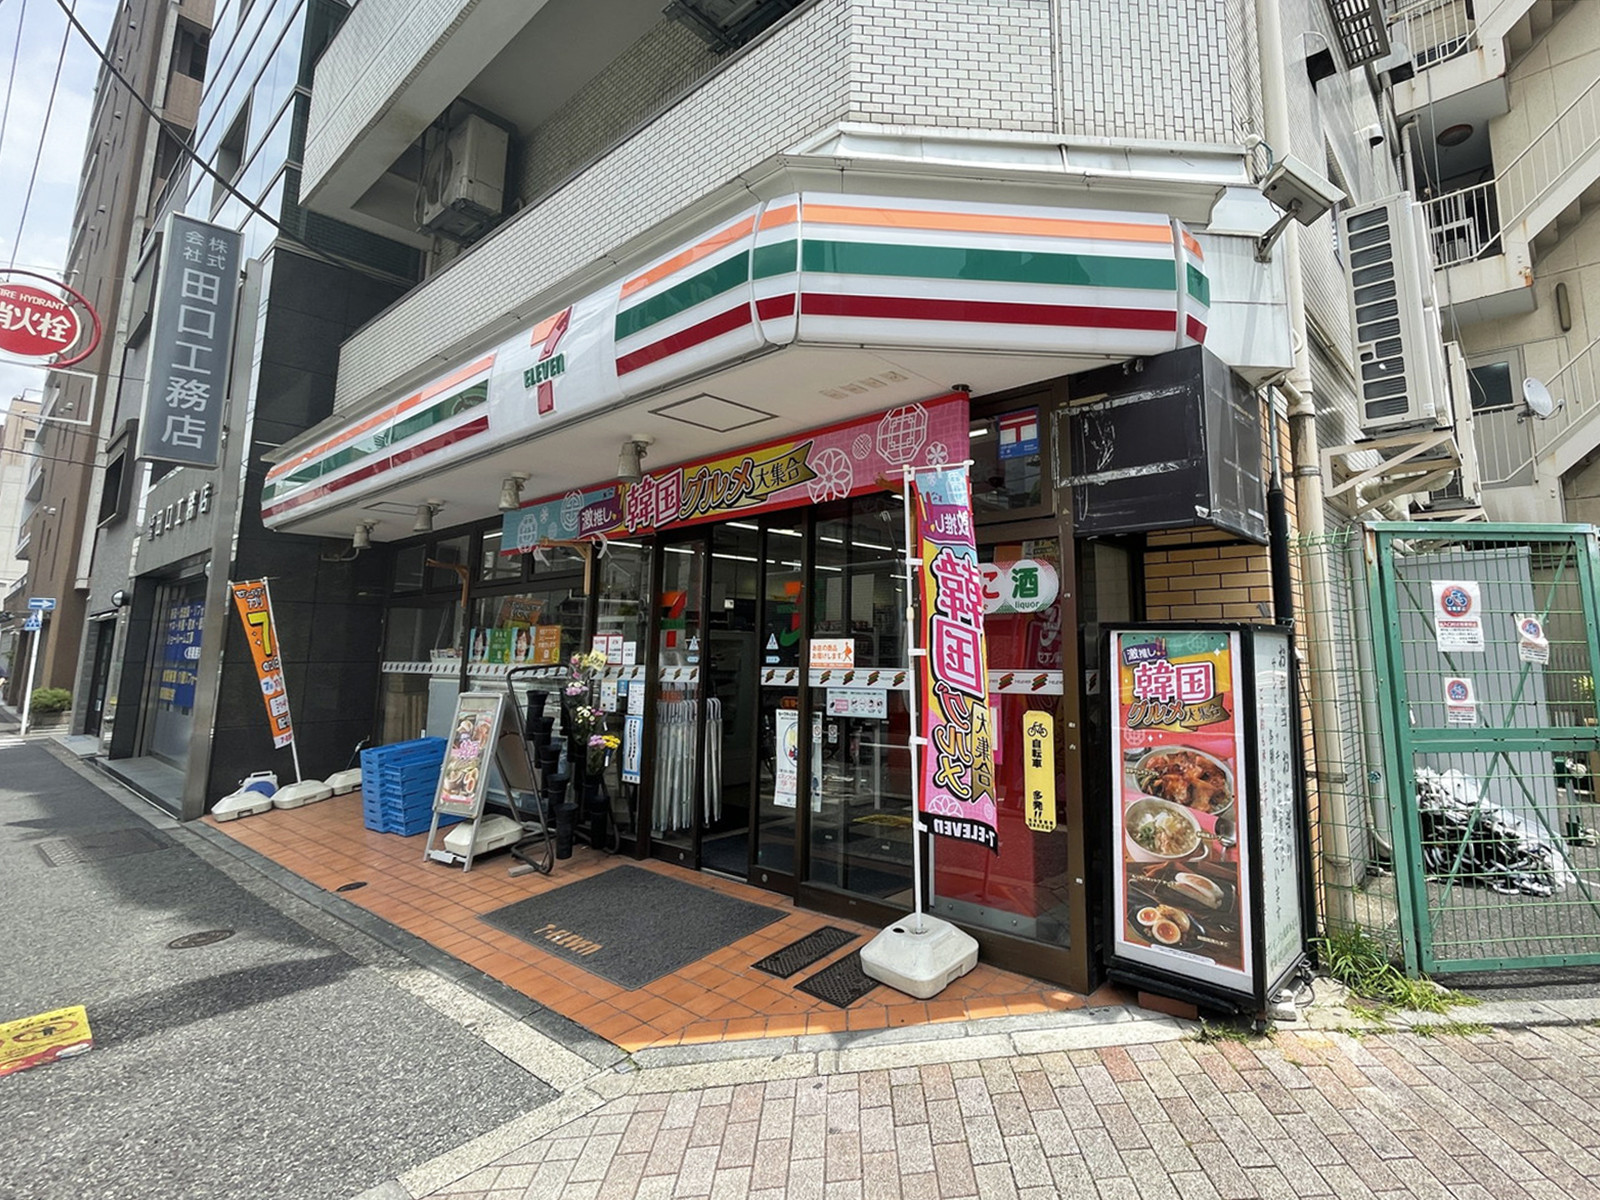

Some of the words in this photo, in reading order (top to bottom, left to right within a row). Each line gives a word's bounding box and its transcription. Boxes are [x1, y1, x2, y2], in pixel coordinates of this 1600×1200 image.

[182, 230, 206, 264] 会社
[207, 236, 228, 270] 株式
[0, 288, 17, 299] IRE
[20, 293, 65, 311] HYDRANT
[0, 301, 71, 343] 消火栓
[161, 267, 221, 450] 田口工務店
[530, 305, 573, 415] 7
[756, 457, 800, 491] 大集合
[1012, 567, 1039, 599] 酒
[1015, 601, 1040, 609] liquor
[1134, 660, 1213, 704] 韓国
[1127, 700, 1184, 726] グルメ
[1185, 704, 1221, 722] 大集合
[1031, 739, 1042, 768] 自転車
